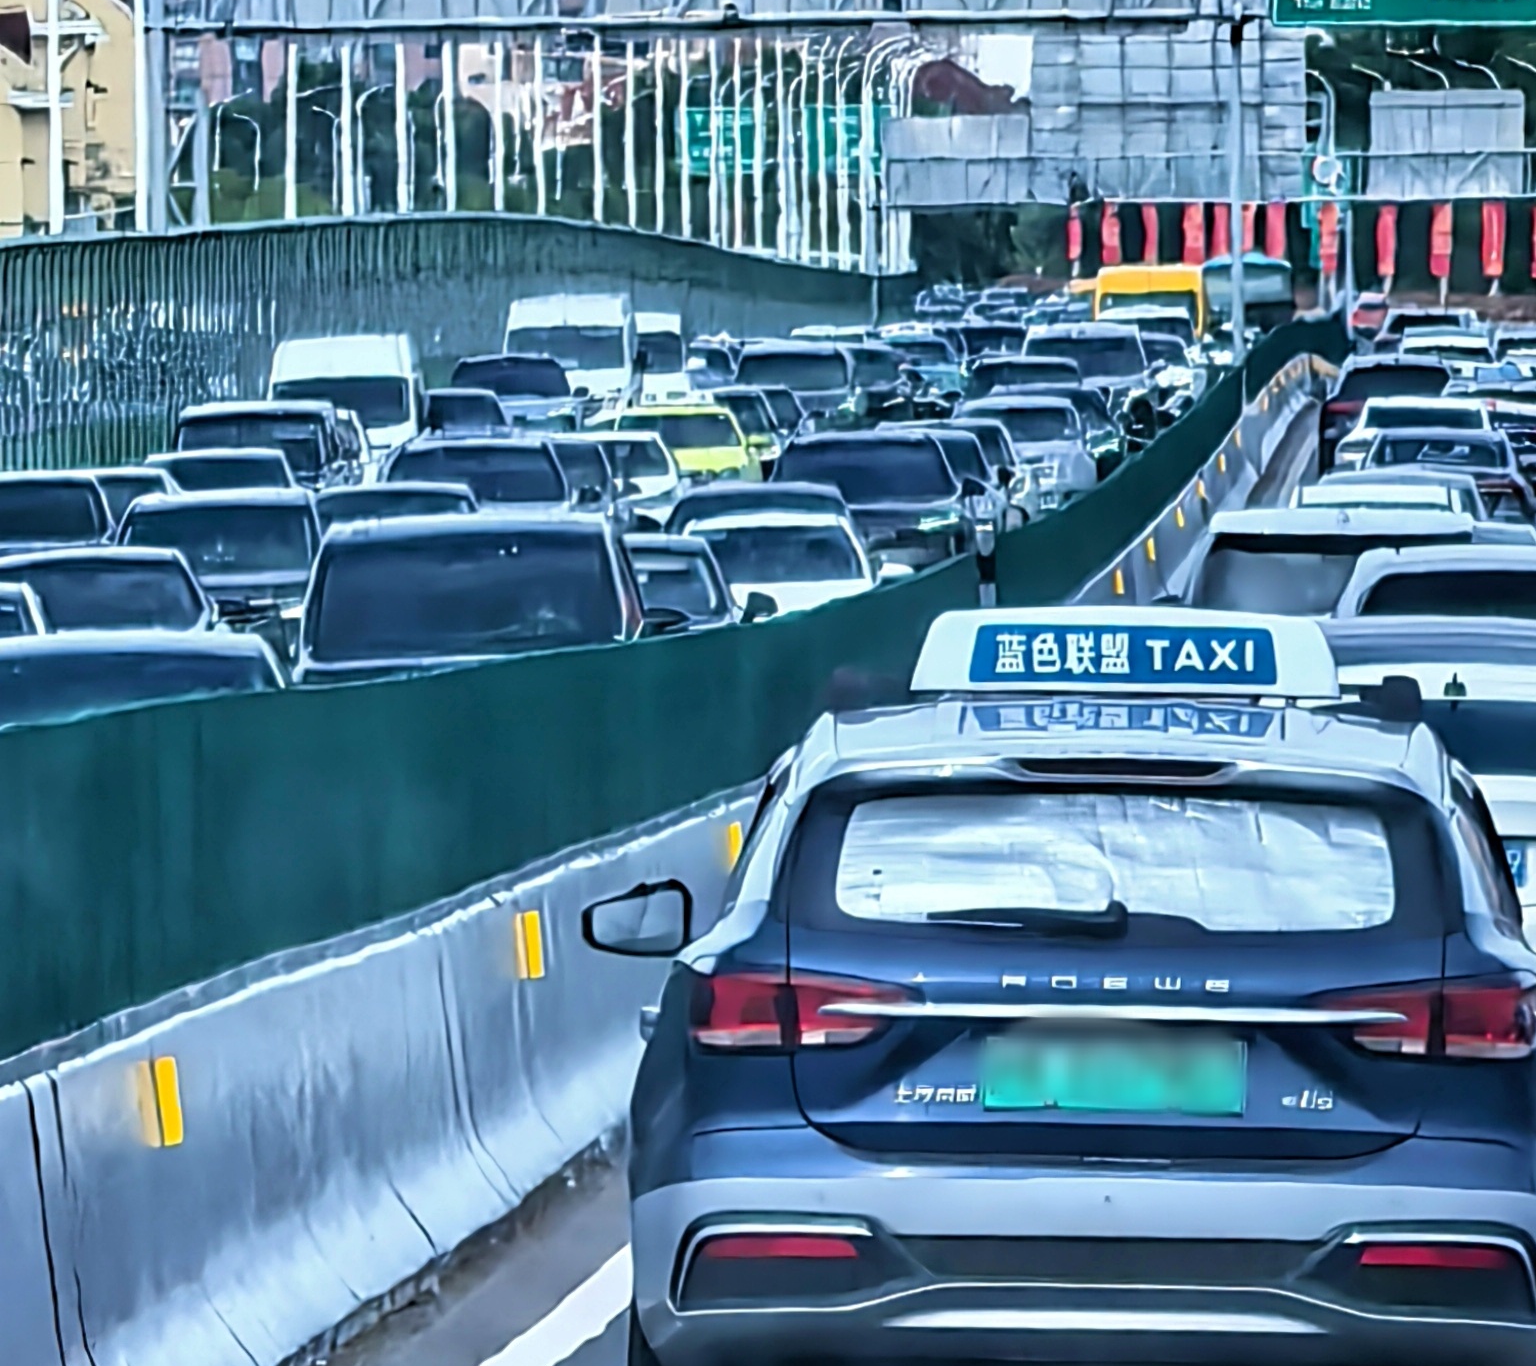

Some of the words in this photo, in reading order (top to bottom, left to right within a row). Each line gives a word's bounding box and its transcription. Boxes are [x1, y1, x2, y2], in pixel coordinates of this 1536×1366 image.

[994, 630, 1131, 675] 蓝色联盟
[1145, 638, 1255, 673] TAXI
